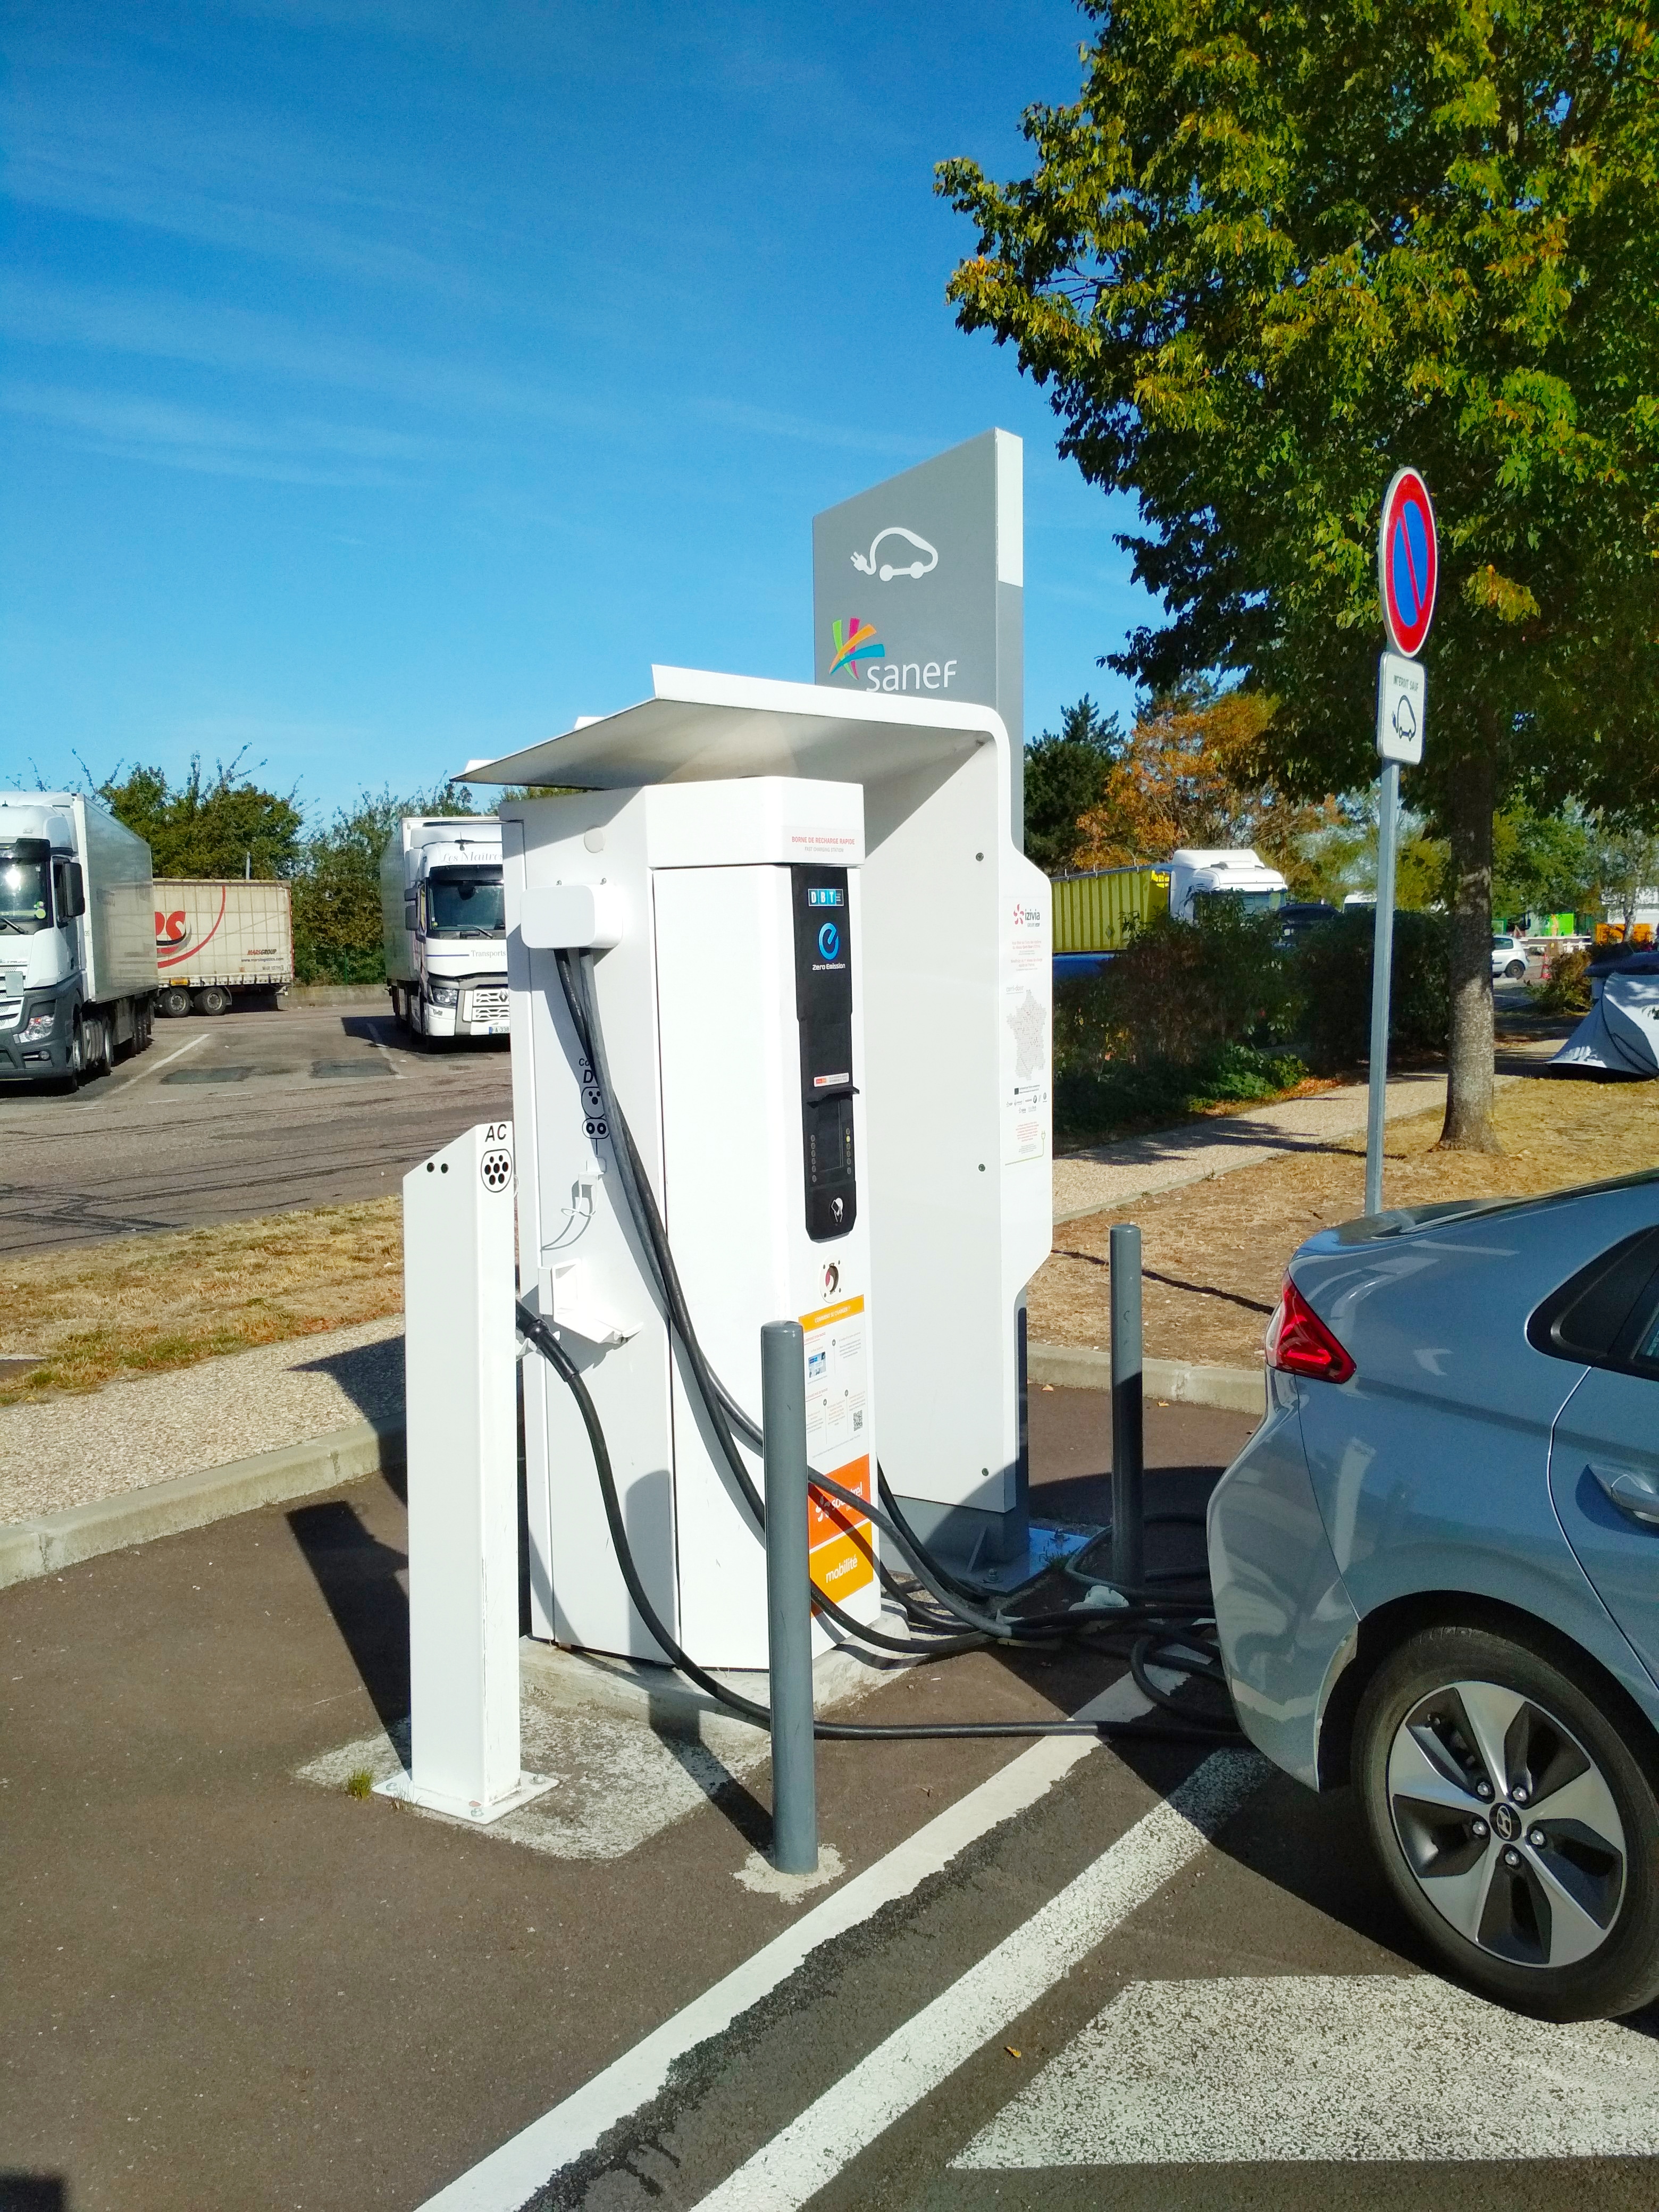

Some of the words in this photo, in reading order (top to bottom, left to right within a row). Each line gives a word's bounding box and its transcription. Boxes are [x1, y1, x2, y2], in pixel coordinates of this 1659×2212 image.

[866, 660, 957, 691] sanef
[1393, 674, 1409, 689] INTERDIT
[1410, 681, 1419, 692] SAUF
[442, 853, 458, 864] Les
[811, 891, 834, 903] DBT
[1025, 909, 1040, 920] izivia
[471, 950, 506, 958] Transports
[484, 1124, 507, 1143] AC
[826, 1554, 858, 1583] mobilité
